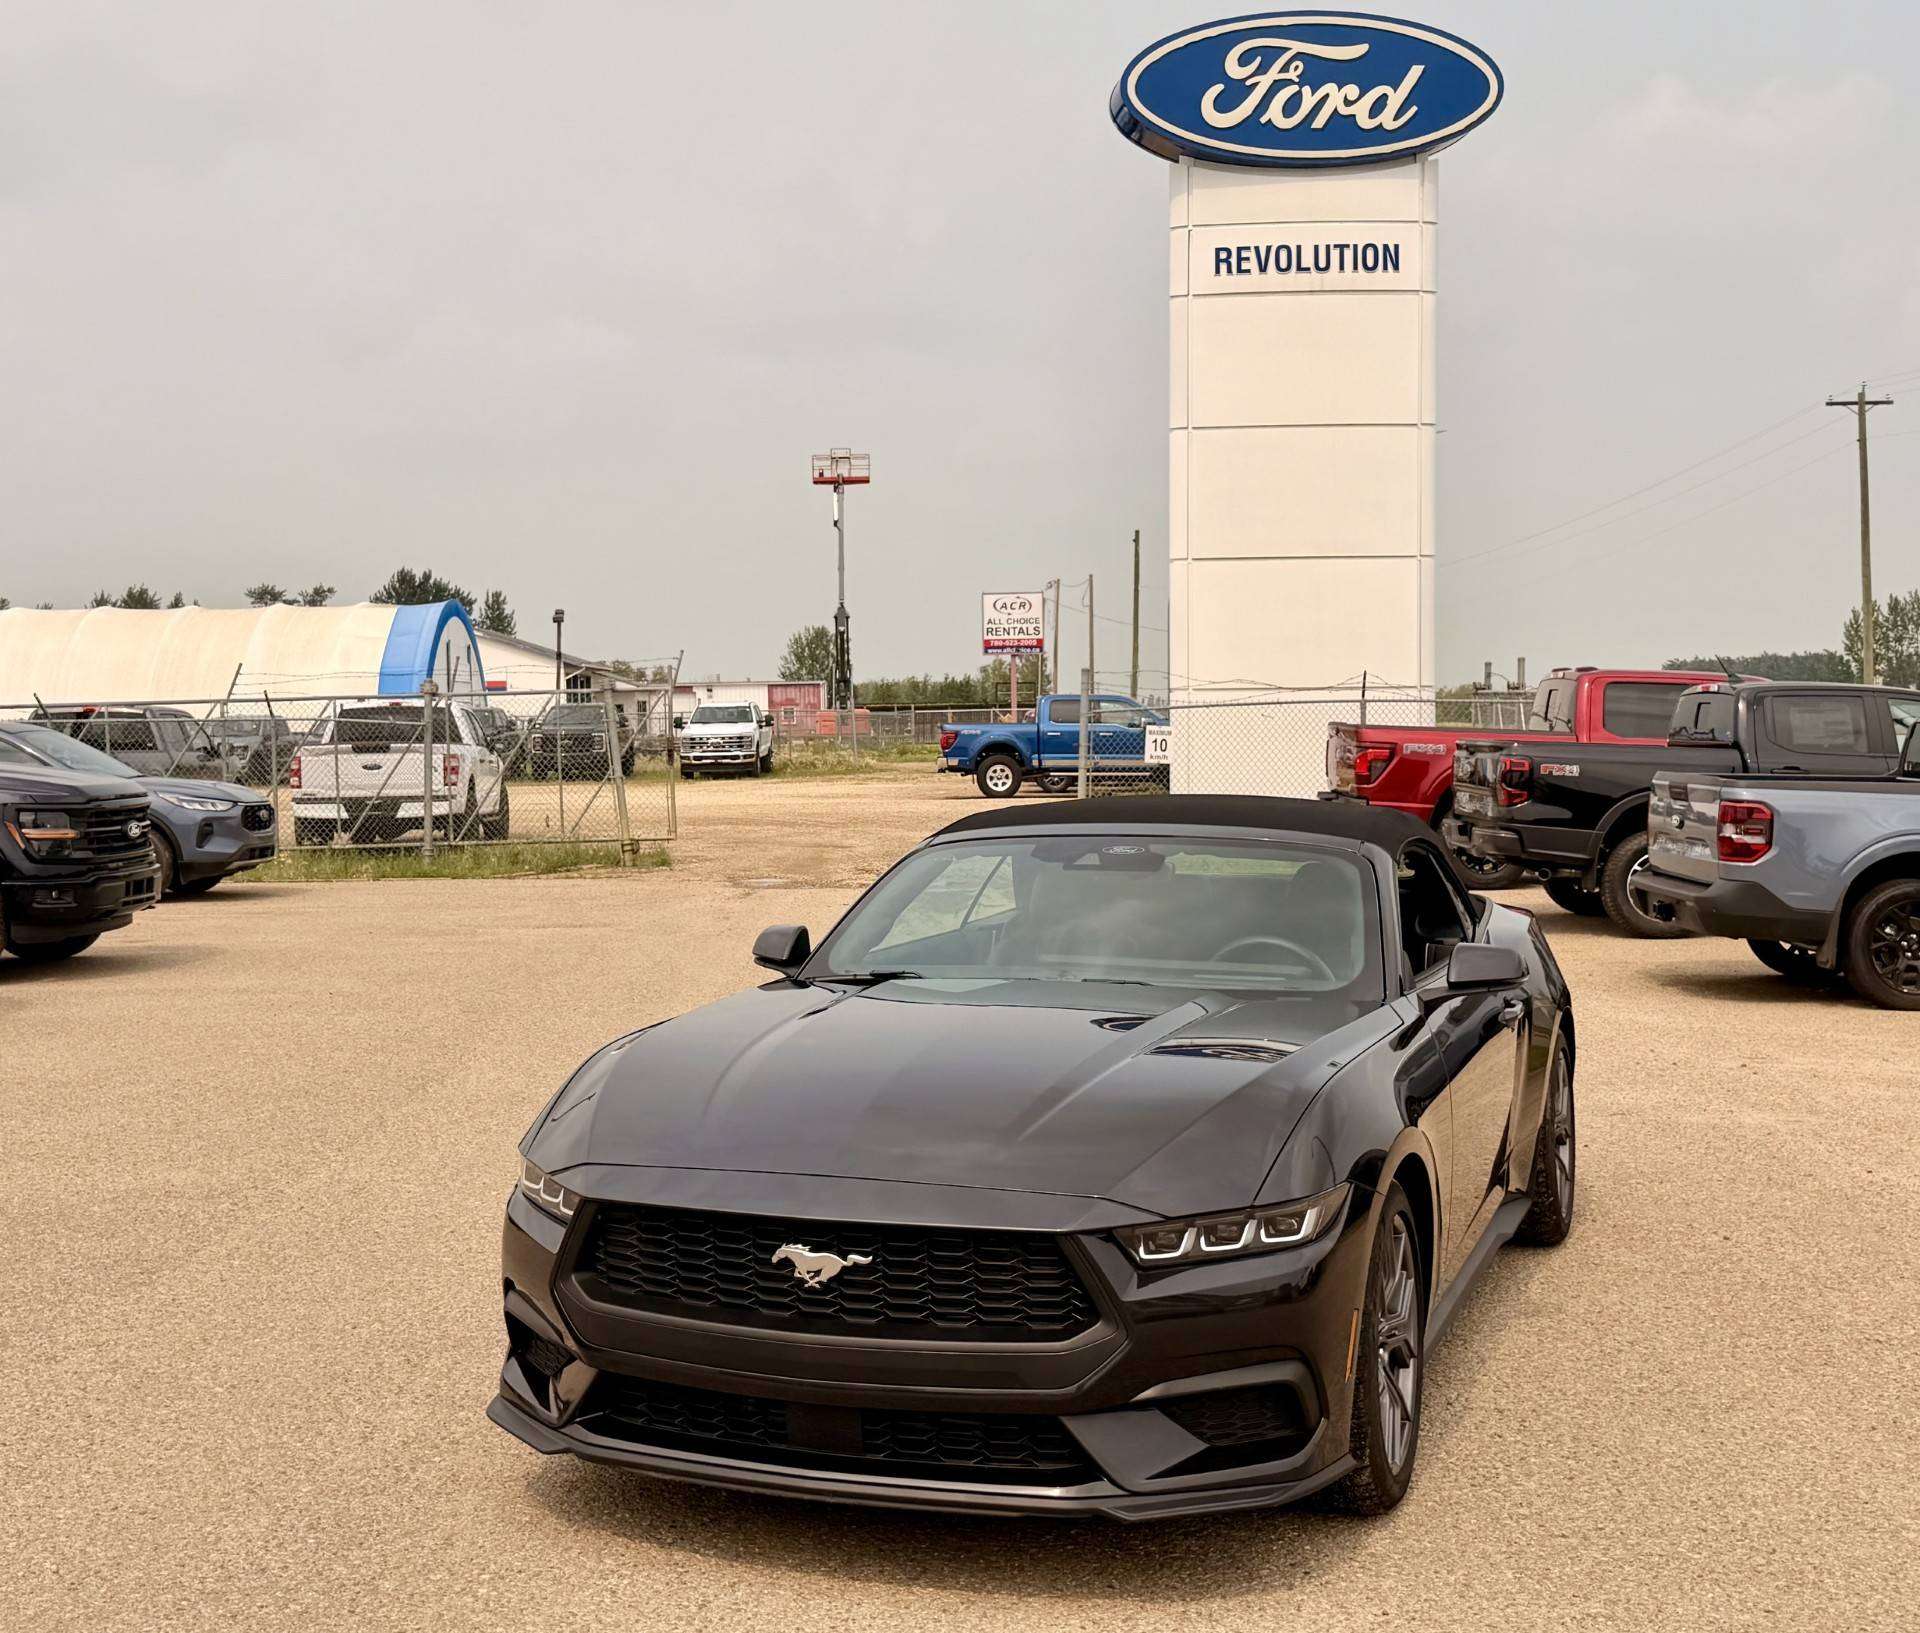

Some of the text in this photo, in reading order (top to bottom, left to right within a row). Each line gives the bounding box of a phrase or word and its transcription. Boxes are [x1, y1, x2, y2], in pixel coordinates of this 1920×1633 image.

[1200, 37, 1425, 131] Ford
[1214, 243, 1401, 275] REVOLUTION
[1000, 601, 1027, 611] ACR
[1006, 617, 1041, 625] CHOICE
[986, 626, 1041, 636] RENTALS
[1152, 738, 1168, 752] 10
[1540, 763, 1580, 777] FX4
